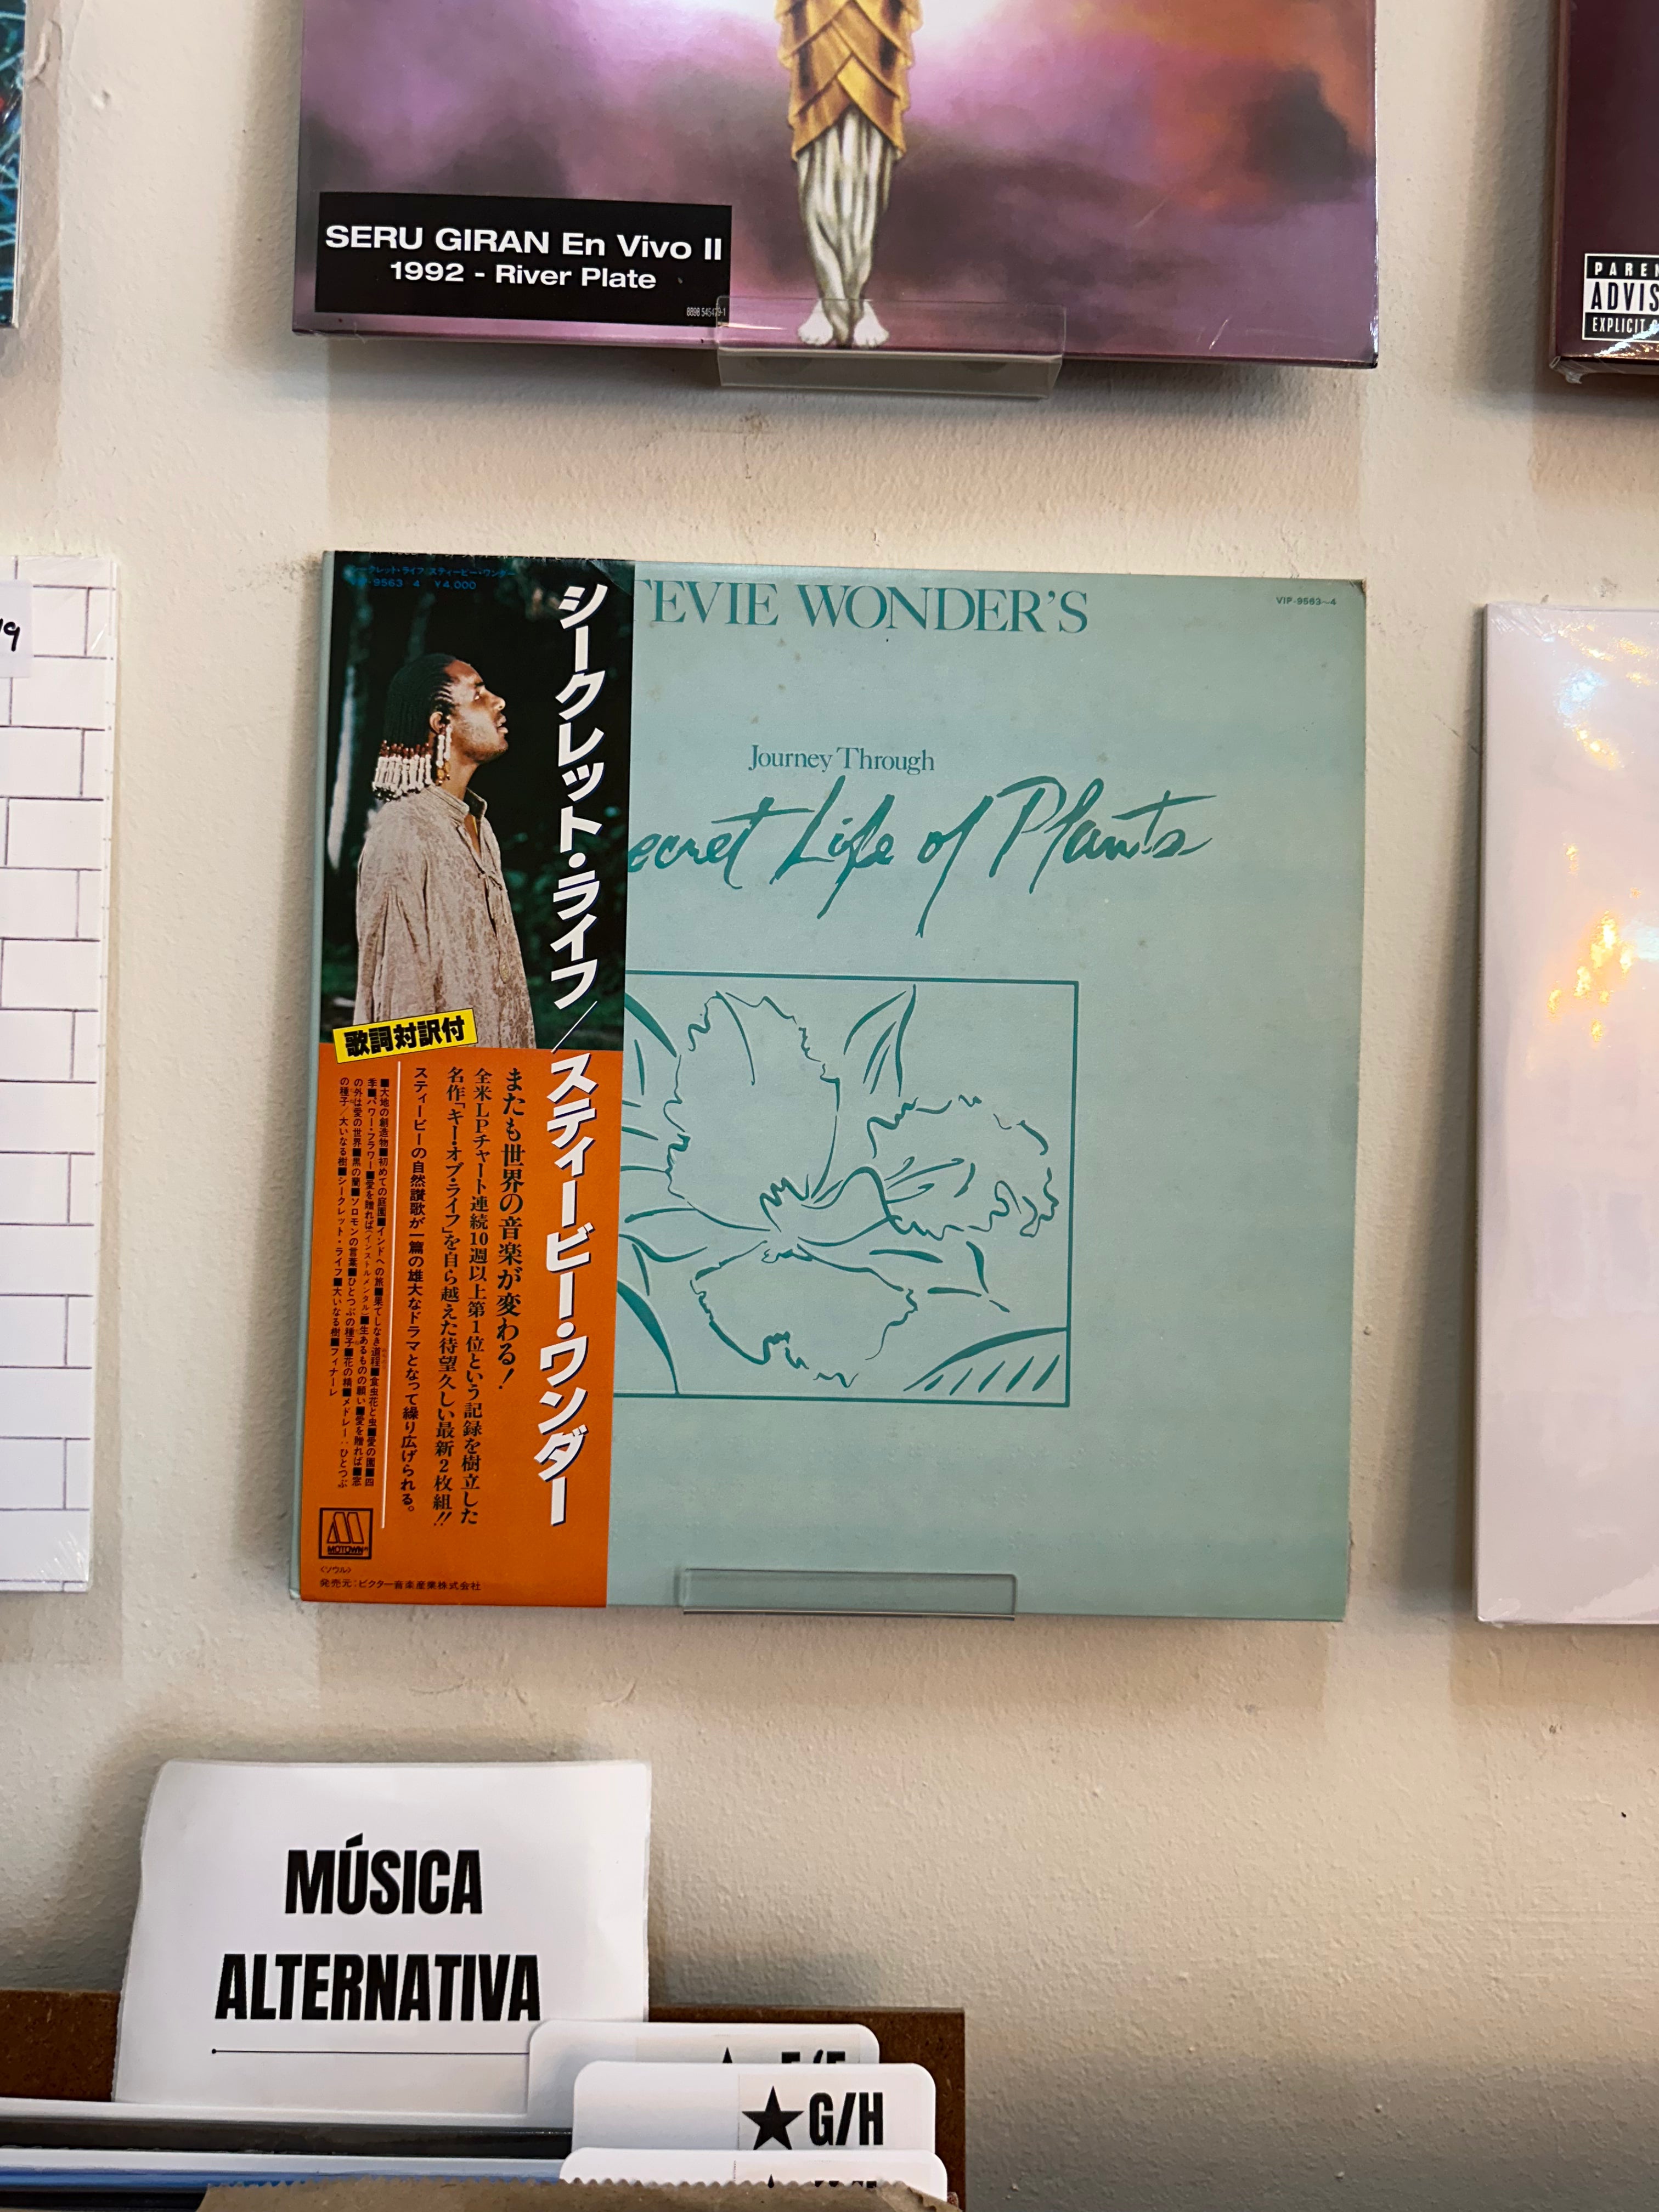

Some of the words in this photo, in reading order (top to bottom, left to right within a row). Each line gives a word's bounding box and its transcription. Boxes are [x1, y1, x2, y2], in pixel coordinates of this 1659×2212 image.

[326, 225, 423, 250] SERU
[435, 228, 550, 255] GIRAN
[562, 233, 606, 256] En
[617, 235, 692, 260] Vivo
[704, 238, 723, 261] II
[390, 262, 464, 283] 1992
[496, 264, 572, 286] River
[582, 268, 657, 290] Plate
[1592, 317, 1645, 334] EXPLICIT
[748, 744, 834, 772] Journey
[837, 746, 936, 775] Through
[628, 796, 814, 890] ecret
[769, 775, 895, 918] Life
[917, 795, 994, 938] of
[989, 775, 1217, 894] Plants
[343, 1014, 465, 1058] 歌詞対訳付
[327, 1545, 364, 1555] MOTOWN
[285, 1832, 483, 1915] MÚSICA
[215, 1953, 541, 2021] ALTERNATIVA
[809, 2092, 884, 2146] G/H
